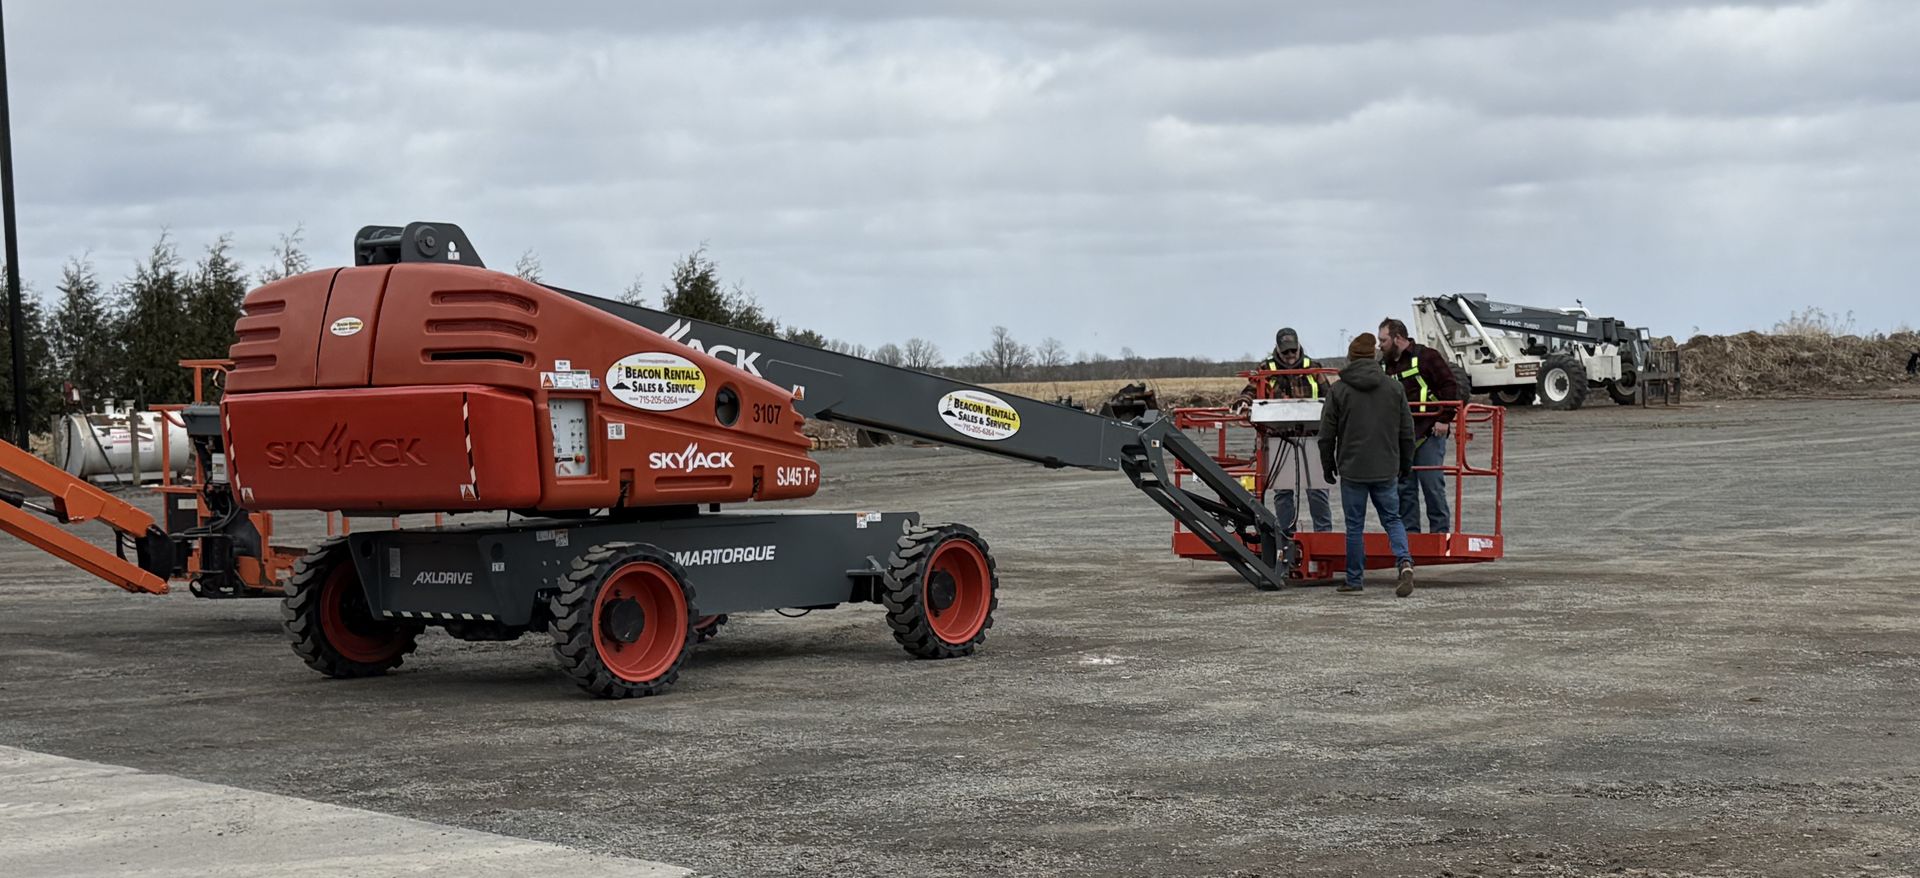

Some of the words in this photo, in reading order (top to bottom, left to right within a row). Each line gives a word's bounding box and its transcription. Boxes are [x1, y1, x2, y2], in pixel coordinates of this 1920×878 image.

[625, 366, 661, 379] BEACON
[664, 367, 700, 381] RENTALS
[632, 381, 656, 393] SALES
[658, 383, 664, 393] &
[666, 382, 696, 394] SERVICE
[639, 395, 678, 405] 715-205-6264
[954, 398, 983, 414] BEACON
[985, 405, 1016, 421] RENTALS
[752, 403, 782, 424] 3107
[958, 411, 978, 424] SALES
[979, 417, 984, 425] &
[986, 417, 1011, 431] SERVICE
[266, 422, 428, 475] SKYJACK
[649, 442, 735, 473] SKYJACK
[776, 466, 802, 486] SJ45
[804, 467, 817, 485] T+
[412, 571, 473, 585] AXLDRIVE
